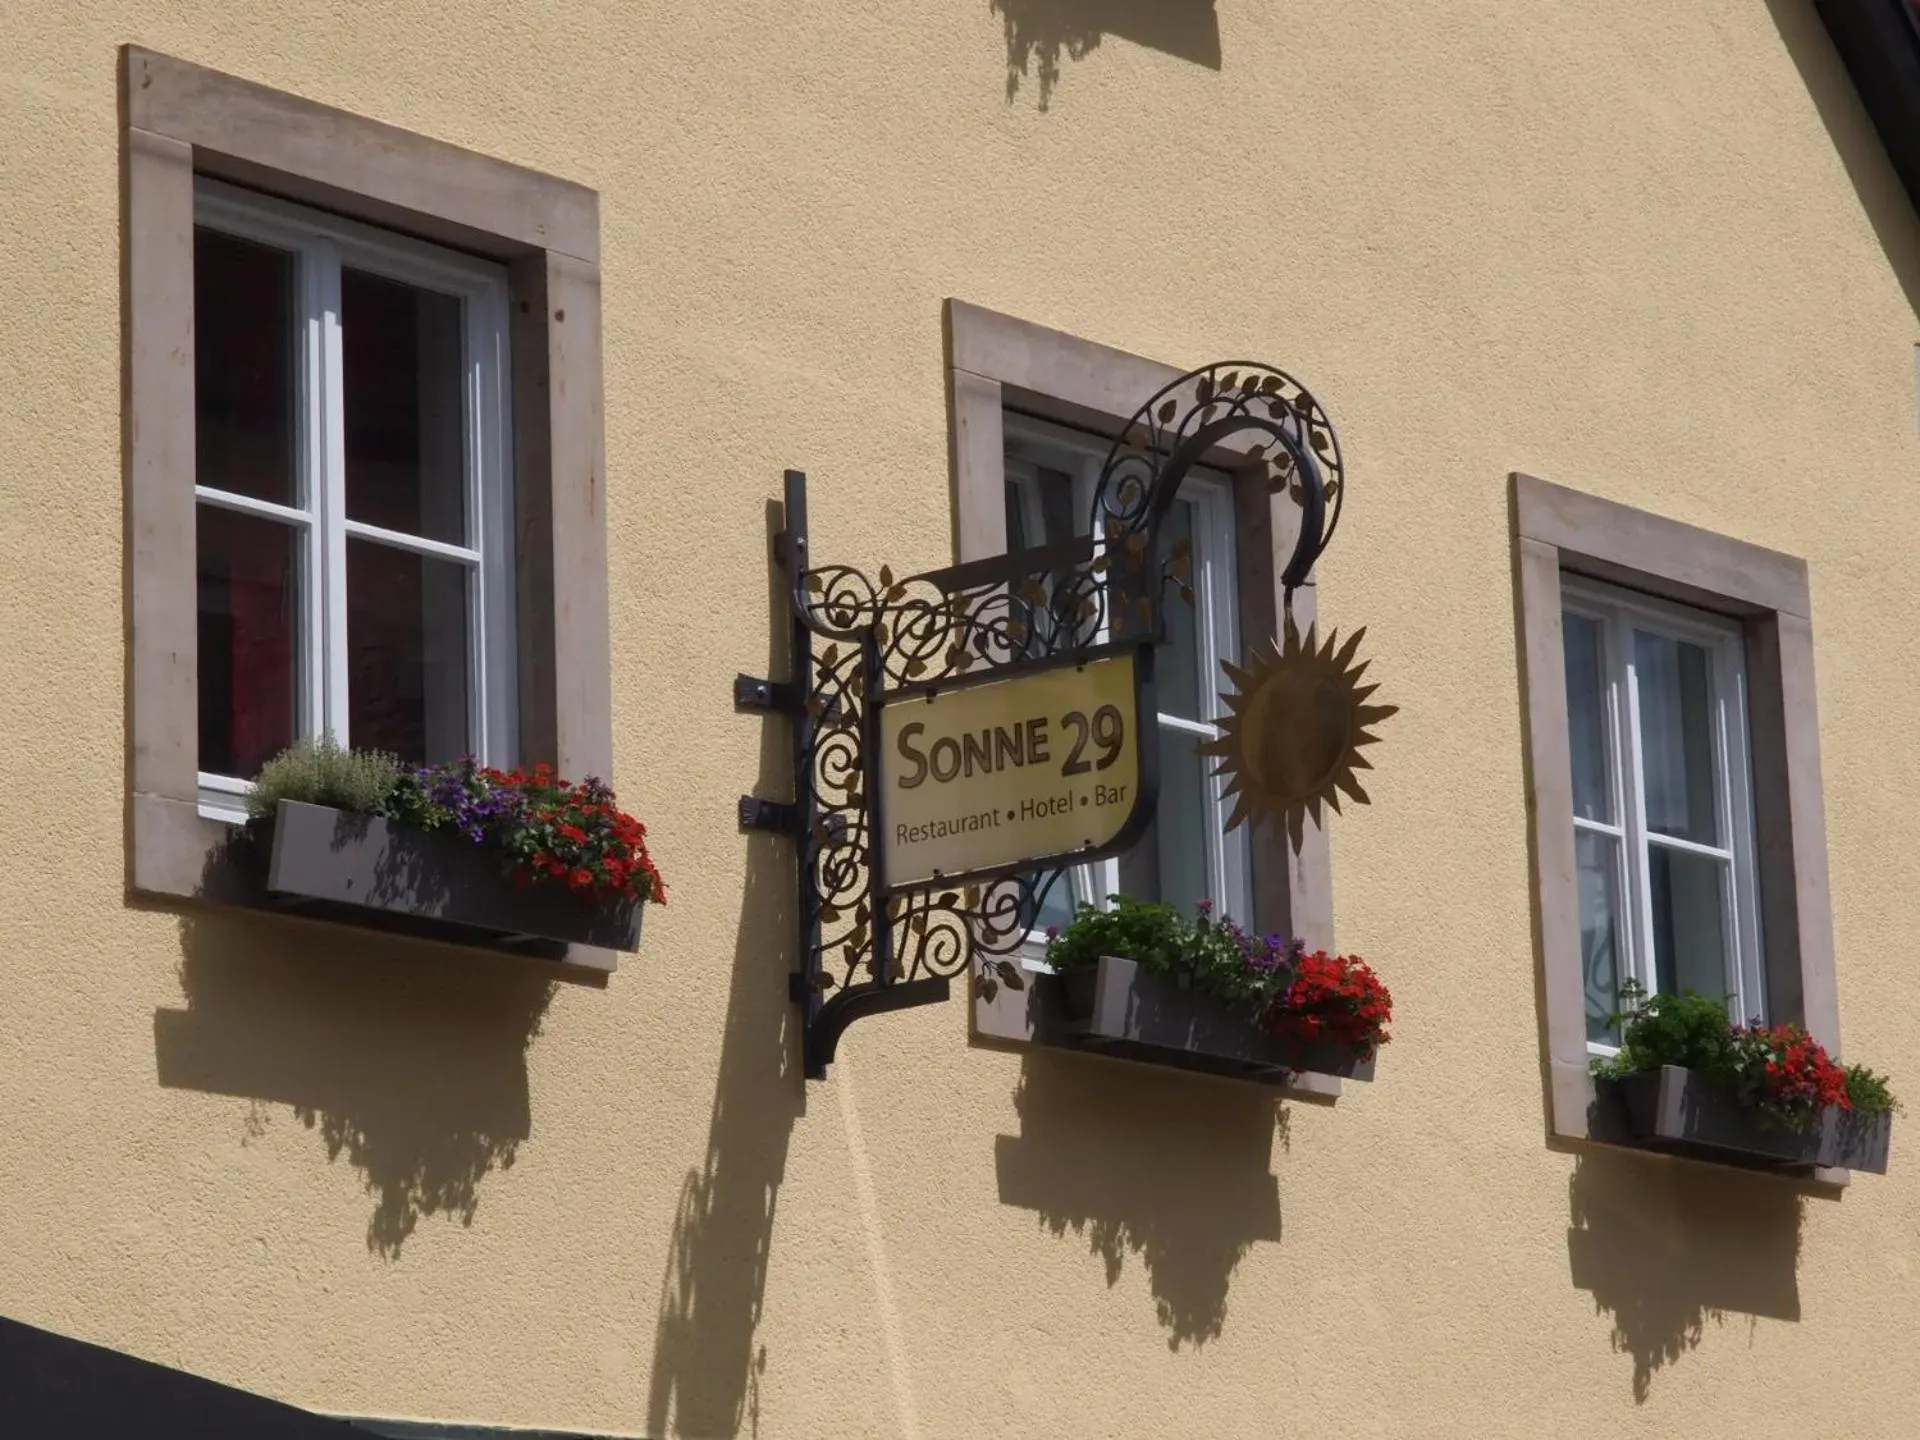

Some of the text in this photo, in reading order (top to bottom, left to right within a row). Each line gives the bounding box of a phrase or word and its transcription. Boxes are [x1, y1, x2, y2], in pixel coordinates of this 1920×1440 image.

[897, 704, 1124, 789] SONNE 29
[896, 784, 1127, 845] Restaurant Hotel Bar
